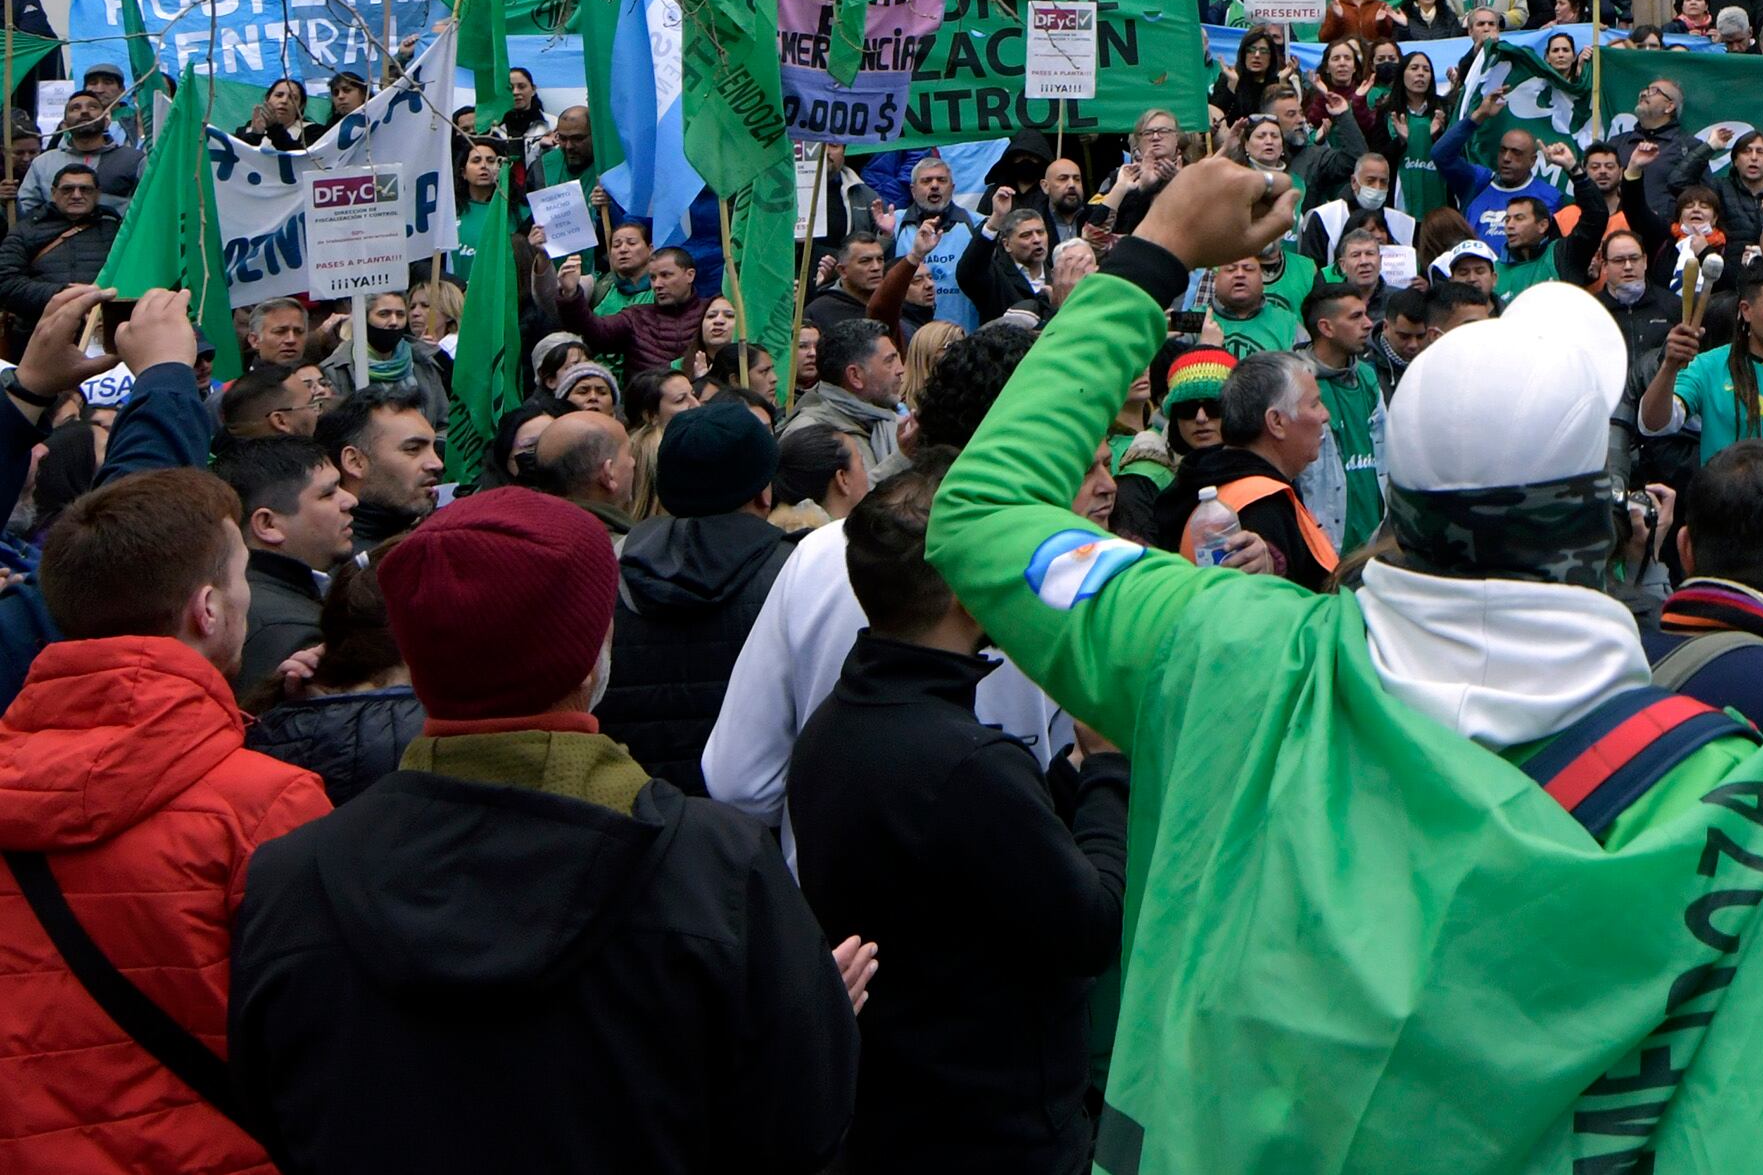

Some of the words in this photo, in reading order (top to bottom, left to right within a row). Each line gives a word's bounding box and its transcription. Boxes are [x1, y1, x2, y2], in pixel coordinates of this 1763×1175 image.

[1035, 14, 1076, 30] DFyC
[1250, 8, 1320, 19] ¡PRESENTE!
[157, 14, 402, 80] ENTRAL
[1040, 84, 1082, 93] ¡¡¡YA!!!
[899, 86, 1099, 139] NTROL
[314, 183, 375, 206] DFyC
[315, 261, 345, 270] PASES
[357, 254, 403, 266] PLANTA!!!
[331, 273, 390, 291] ¡¡¡YA!!!
